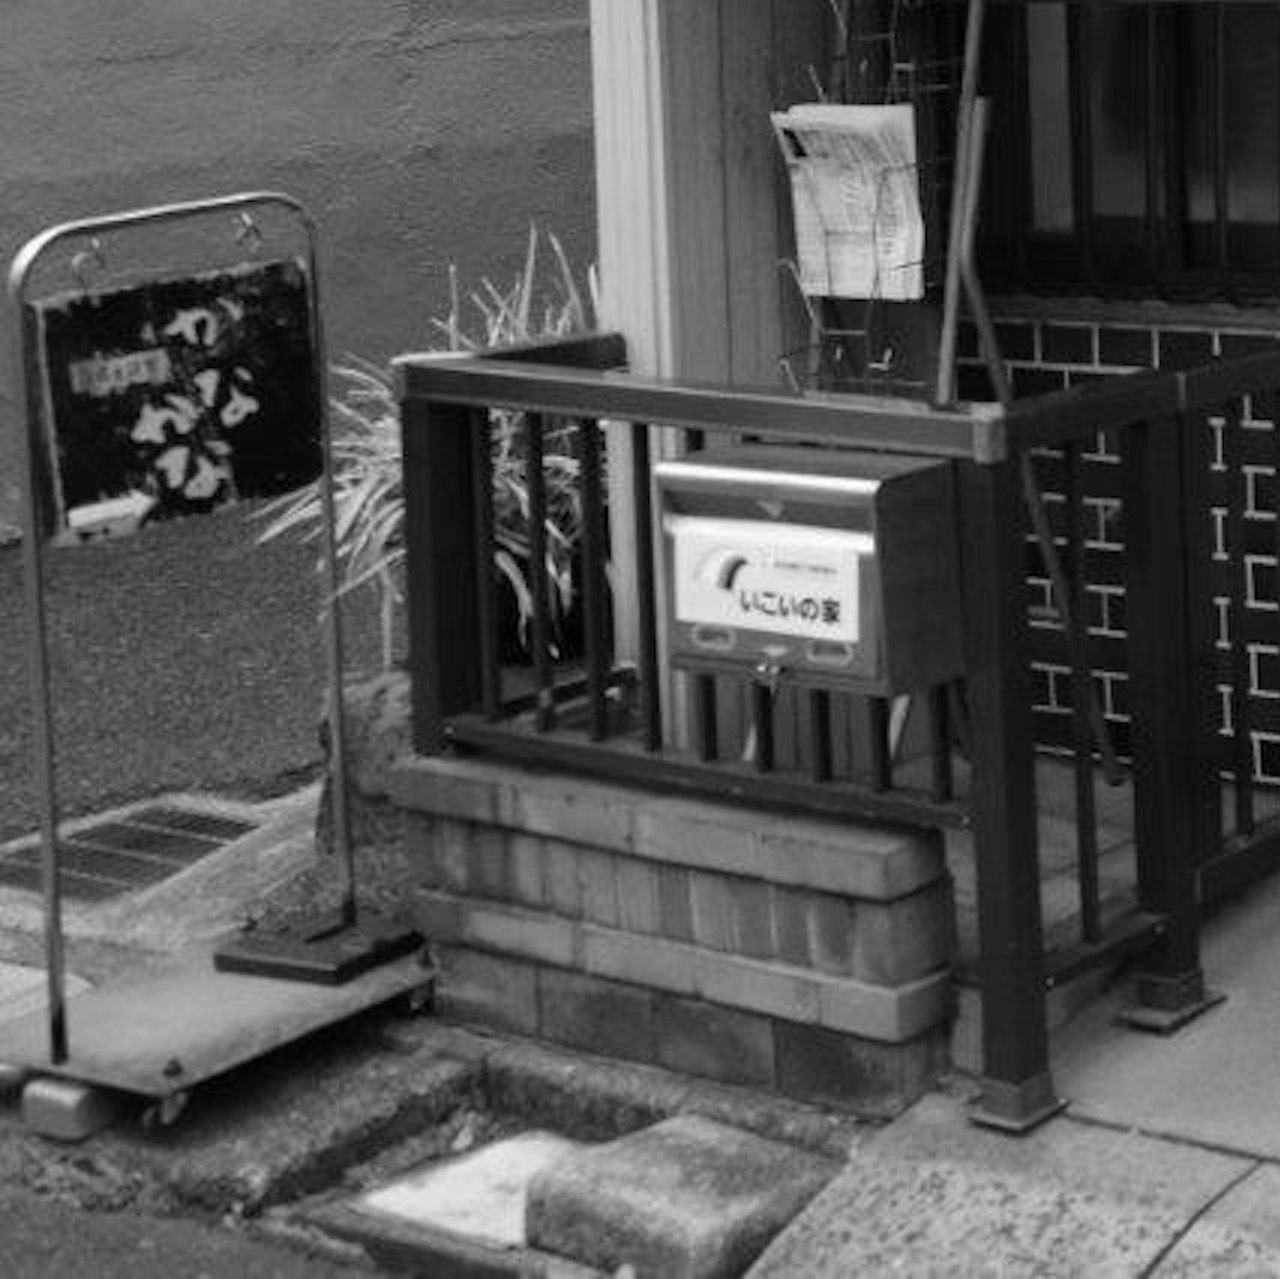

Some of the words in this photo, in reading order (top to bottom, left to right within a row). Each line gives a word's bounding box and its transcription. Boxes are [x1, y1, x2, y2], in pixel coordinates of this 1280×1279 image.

[740, 589, 840, 623] いこいの家
